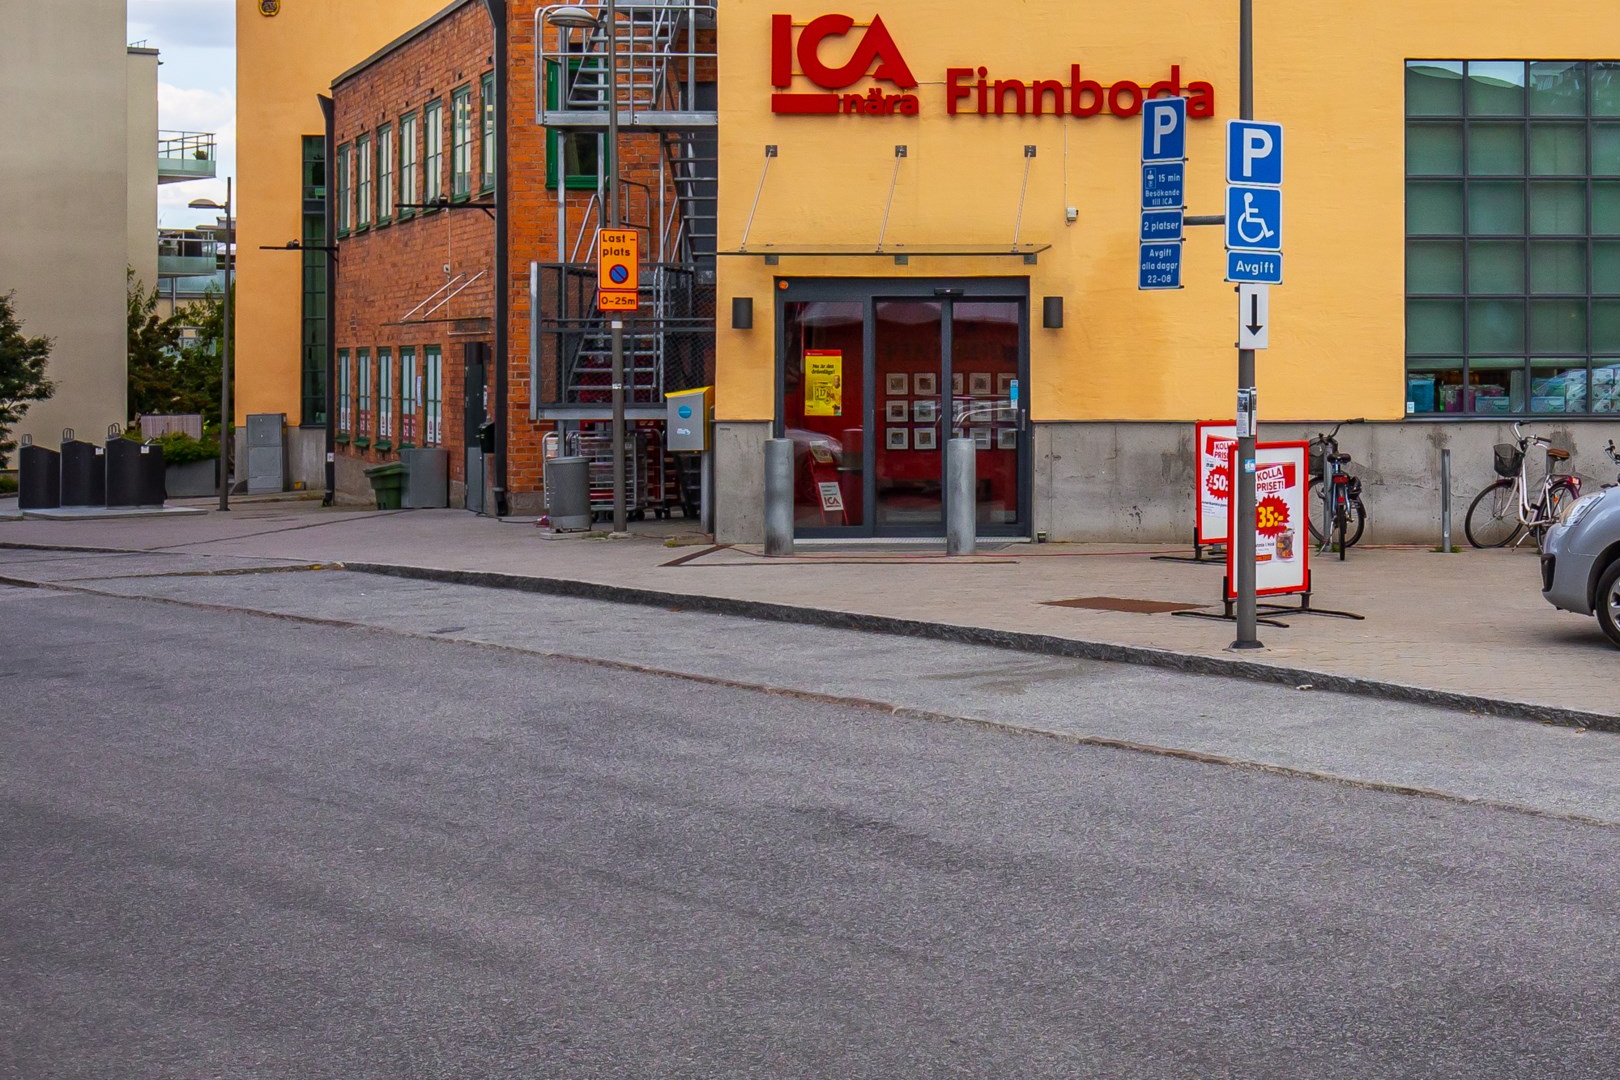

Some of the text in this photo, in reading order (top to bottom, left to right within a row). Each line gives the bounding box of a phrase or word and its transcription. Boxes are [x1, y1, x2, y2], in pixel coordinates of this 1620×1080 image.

[772, 13, 919, 89] ICA
[946, 63, 1214, 118] Finnboda
[843, 88, 919, 115] nära
[1153, 105, 1178, 155] P
[1243, 127, 1273, 177] P
[1158, 173, 1181, 182] 15 min
[1145, 189, 1180, 198] Besökande
[1162, 197, 1173, 205] ICA
[1143, 221, 1179, 232] 2 platser
[602, 247, 631, 258] plats
[1149, 248, 1172, 259] Avgift
[1142, 261, 1178, 272] alla dagar
[1236, 260, 1274, 276] Avgift
[1147, 275, 1172, 283] 22-08
[1214, 450, 1228, 459] PRIS
[1257, 468, 1282, 481] KOLLA
[1257, 481, 1284, 491] PRISET!
[823, 496, 840, 505] ICA
[1258, 506, 1283, 528] 35:-
